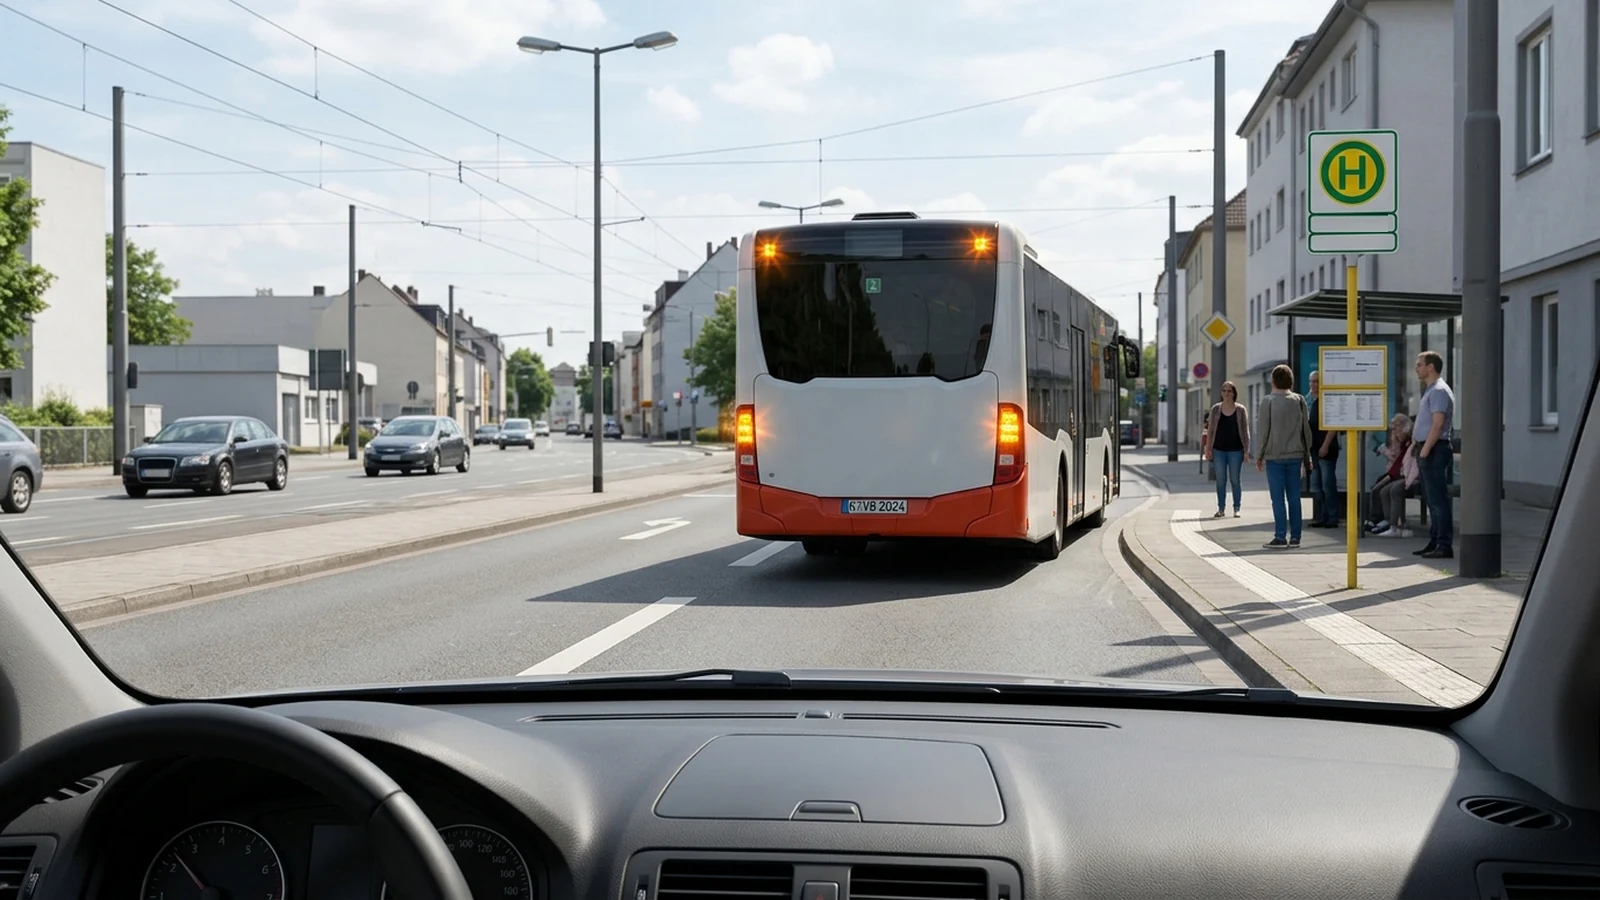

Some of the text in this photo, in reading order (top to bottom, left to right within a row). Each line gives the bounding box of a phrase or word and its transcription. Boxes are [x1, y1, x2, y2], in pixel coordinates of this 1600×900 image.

[1339, 155, 1366, 190] H
[878, 501, 905, 512] 2024
[218, 836, 225, 845] 4
[459, 840, 473, 848] 100
[192, 844, 198, 853] 3
[478, 844, 492, 853] 120
[169, 863, 177, 873] 2
[261, 865, 269, 874] 6
[500, 869, 515, 877] 160
